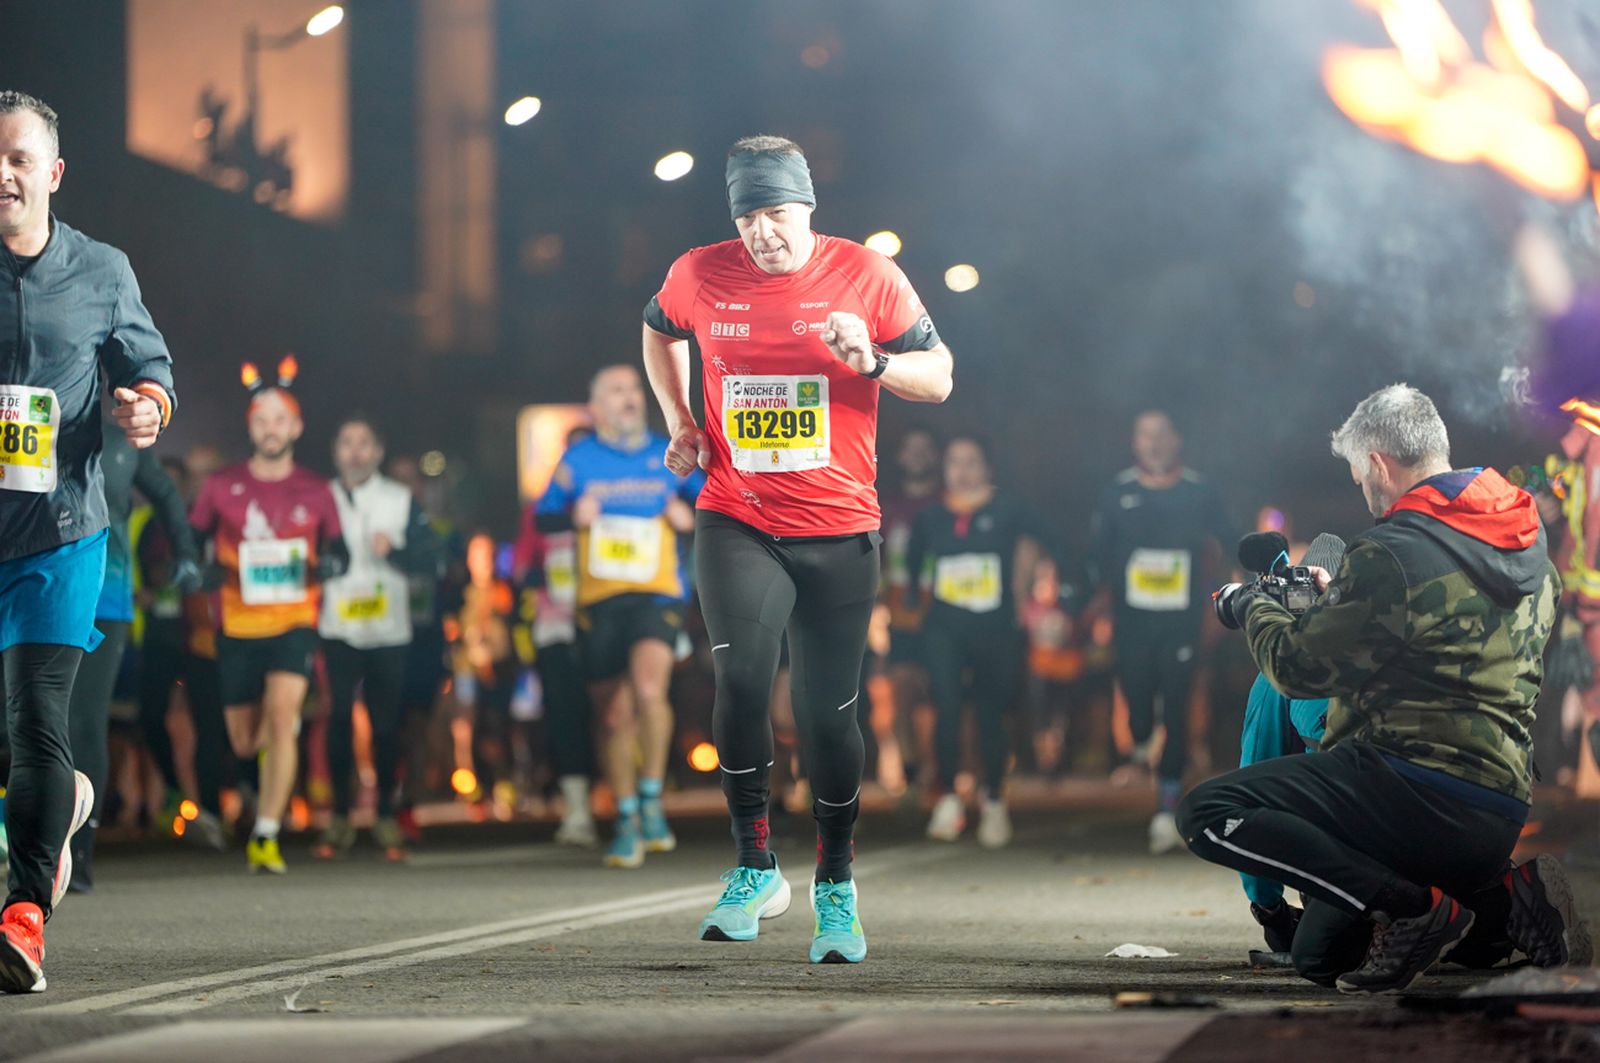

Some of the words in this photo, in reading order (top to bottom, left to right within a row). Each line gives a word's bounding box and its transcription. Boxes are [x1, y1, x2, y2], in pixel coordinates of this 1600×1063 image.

[711, 322, 750, 336] BTG
[743, 386, 773, 396] NOCHE
[776, 386, 788, 396] DE
[7, 397, 20, 407] DE
[733, 398, 751, 408] SAN
[753, 395, 788, 408] ANTÓN
[733, 410, 816, 439] 13299
[0, 423, 38, 455] 86
